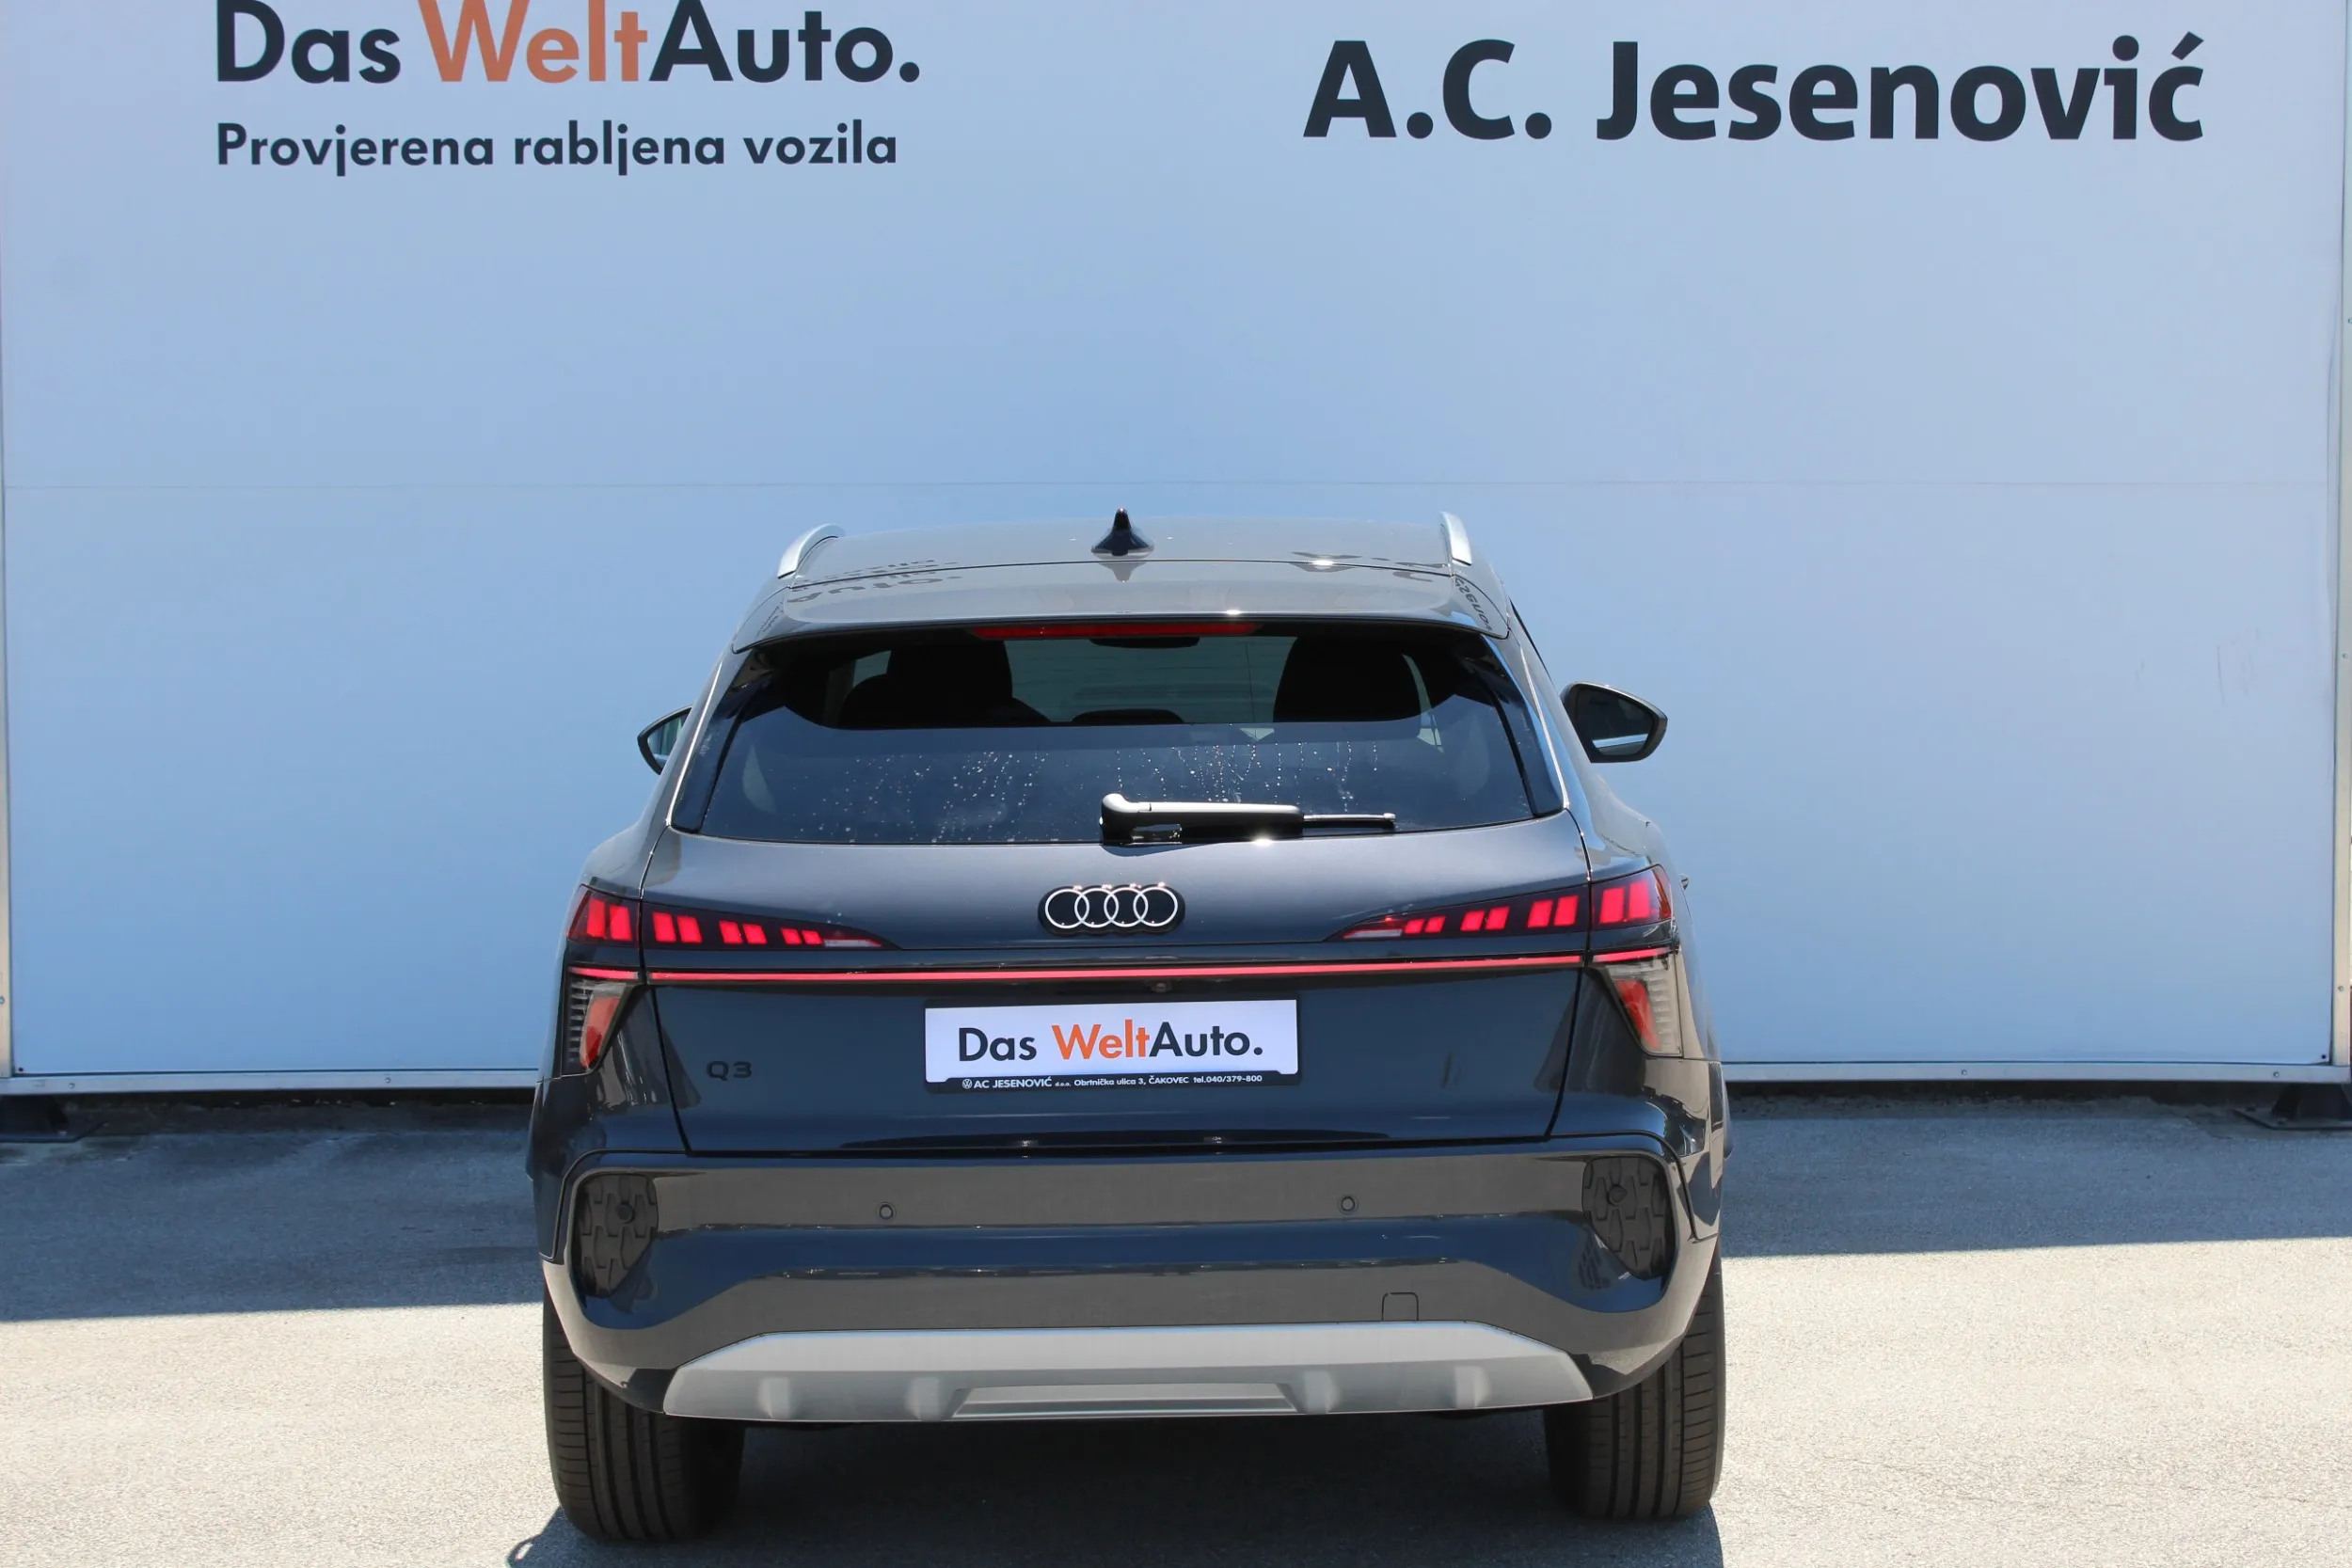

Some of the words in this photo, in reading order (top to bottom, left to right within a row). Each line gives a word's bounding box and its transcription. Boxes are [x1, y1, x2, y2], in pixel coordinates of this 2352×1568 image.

[217, 0, 401, 85] Das
[420, 0, 920, 85] WeltAuto.
[1303, 39, 1552, 140] A.C.
[1596, 31, 2204, 142] Jesenović
[217, 122, 494, 177] Provjerena
[515, 120, 724, 177] rabljena
[743, 119, 897, 166] vozila
[958, 1027, 1038, 1062] Das
[1051, 1019, 1263, 1060] WeltAuto.
[707, 1060, 753, 1082] Q3
[973, 1080, 990, 1089] AC
[993, 1076, 1053, 1088] JESENOVIĆ
[1073, 1078, 1115, 1086] Obrtnička
[1116, 1077, 1136, 1085] ulica
[1137, 1077, 1147, 1086] 3,
[1149, 1075, 1189, 1085] ČAKOVEC
